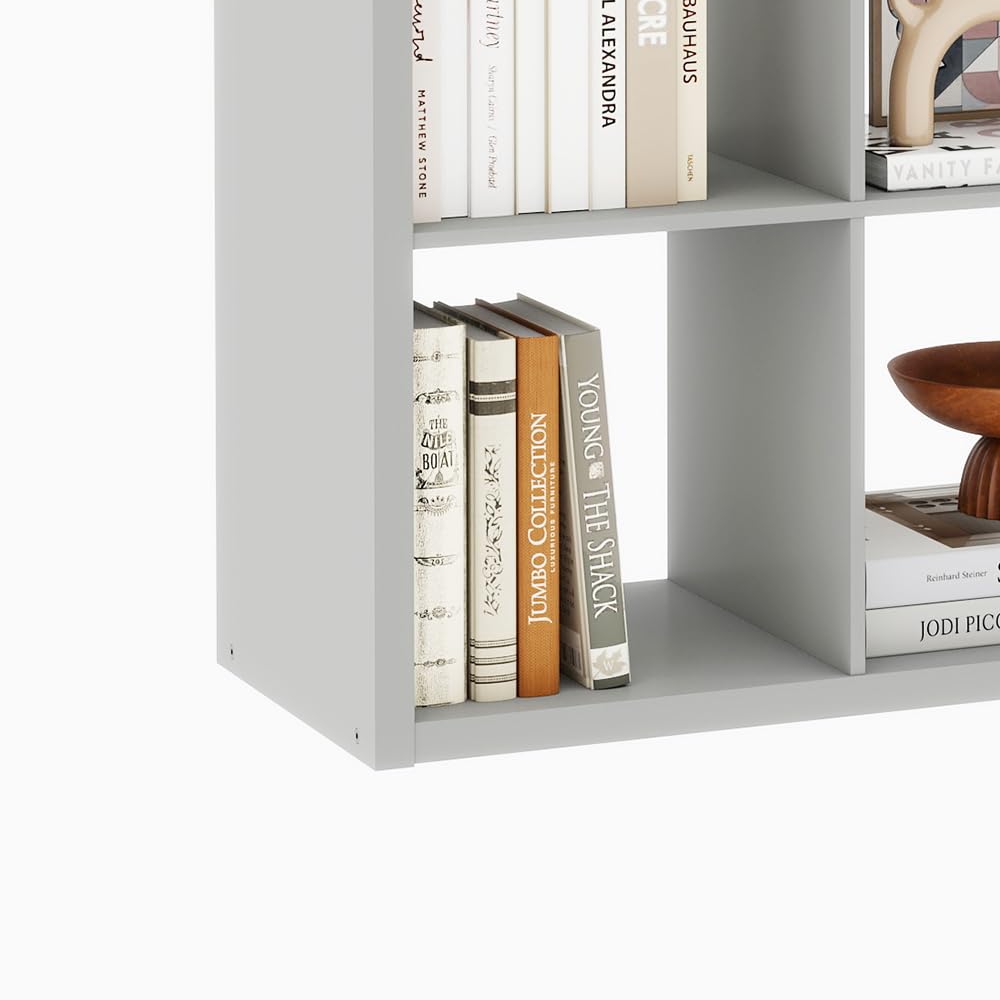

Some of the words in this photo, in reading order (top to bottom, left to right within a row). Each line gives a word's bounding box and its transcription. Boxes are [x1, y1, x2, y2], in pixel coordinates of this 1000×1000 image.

[601, 13, 617, 129] ALEXANDRA
[418, 89, 427, 151] MATTHEW
[418, 157, 427, 199] STONE
[893, 158, 972, 182] VANITY
[429, 418, 448, 430] THE
[577, 372, 604, 462] YOUNG
[422, 450, 453, 470] BOAT
[527, 413, 549, 546] COLLECTION
[583, 483, 611, 533] THE
[527, 555, 553, 625] JUMBO
[590, 539, 618, 620] SHACK
[926, 571, 961, 583] Reinhard
[961, 570, 988, 580] Steiner
[919, 616, 960, 642] JODI
